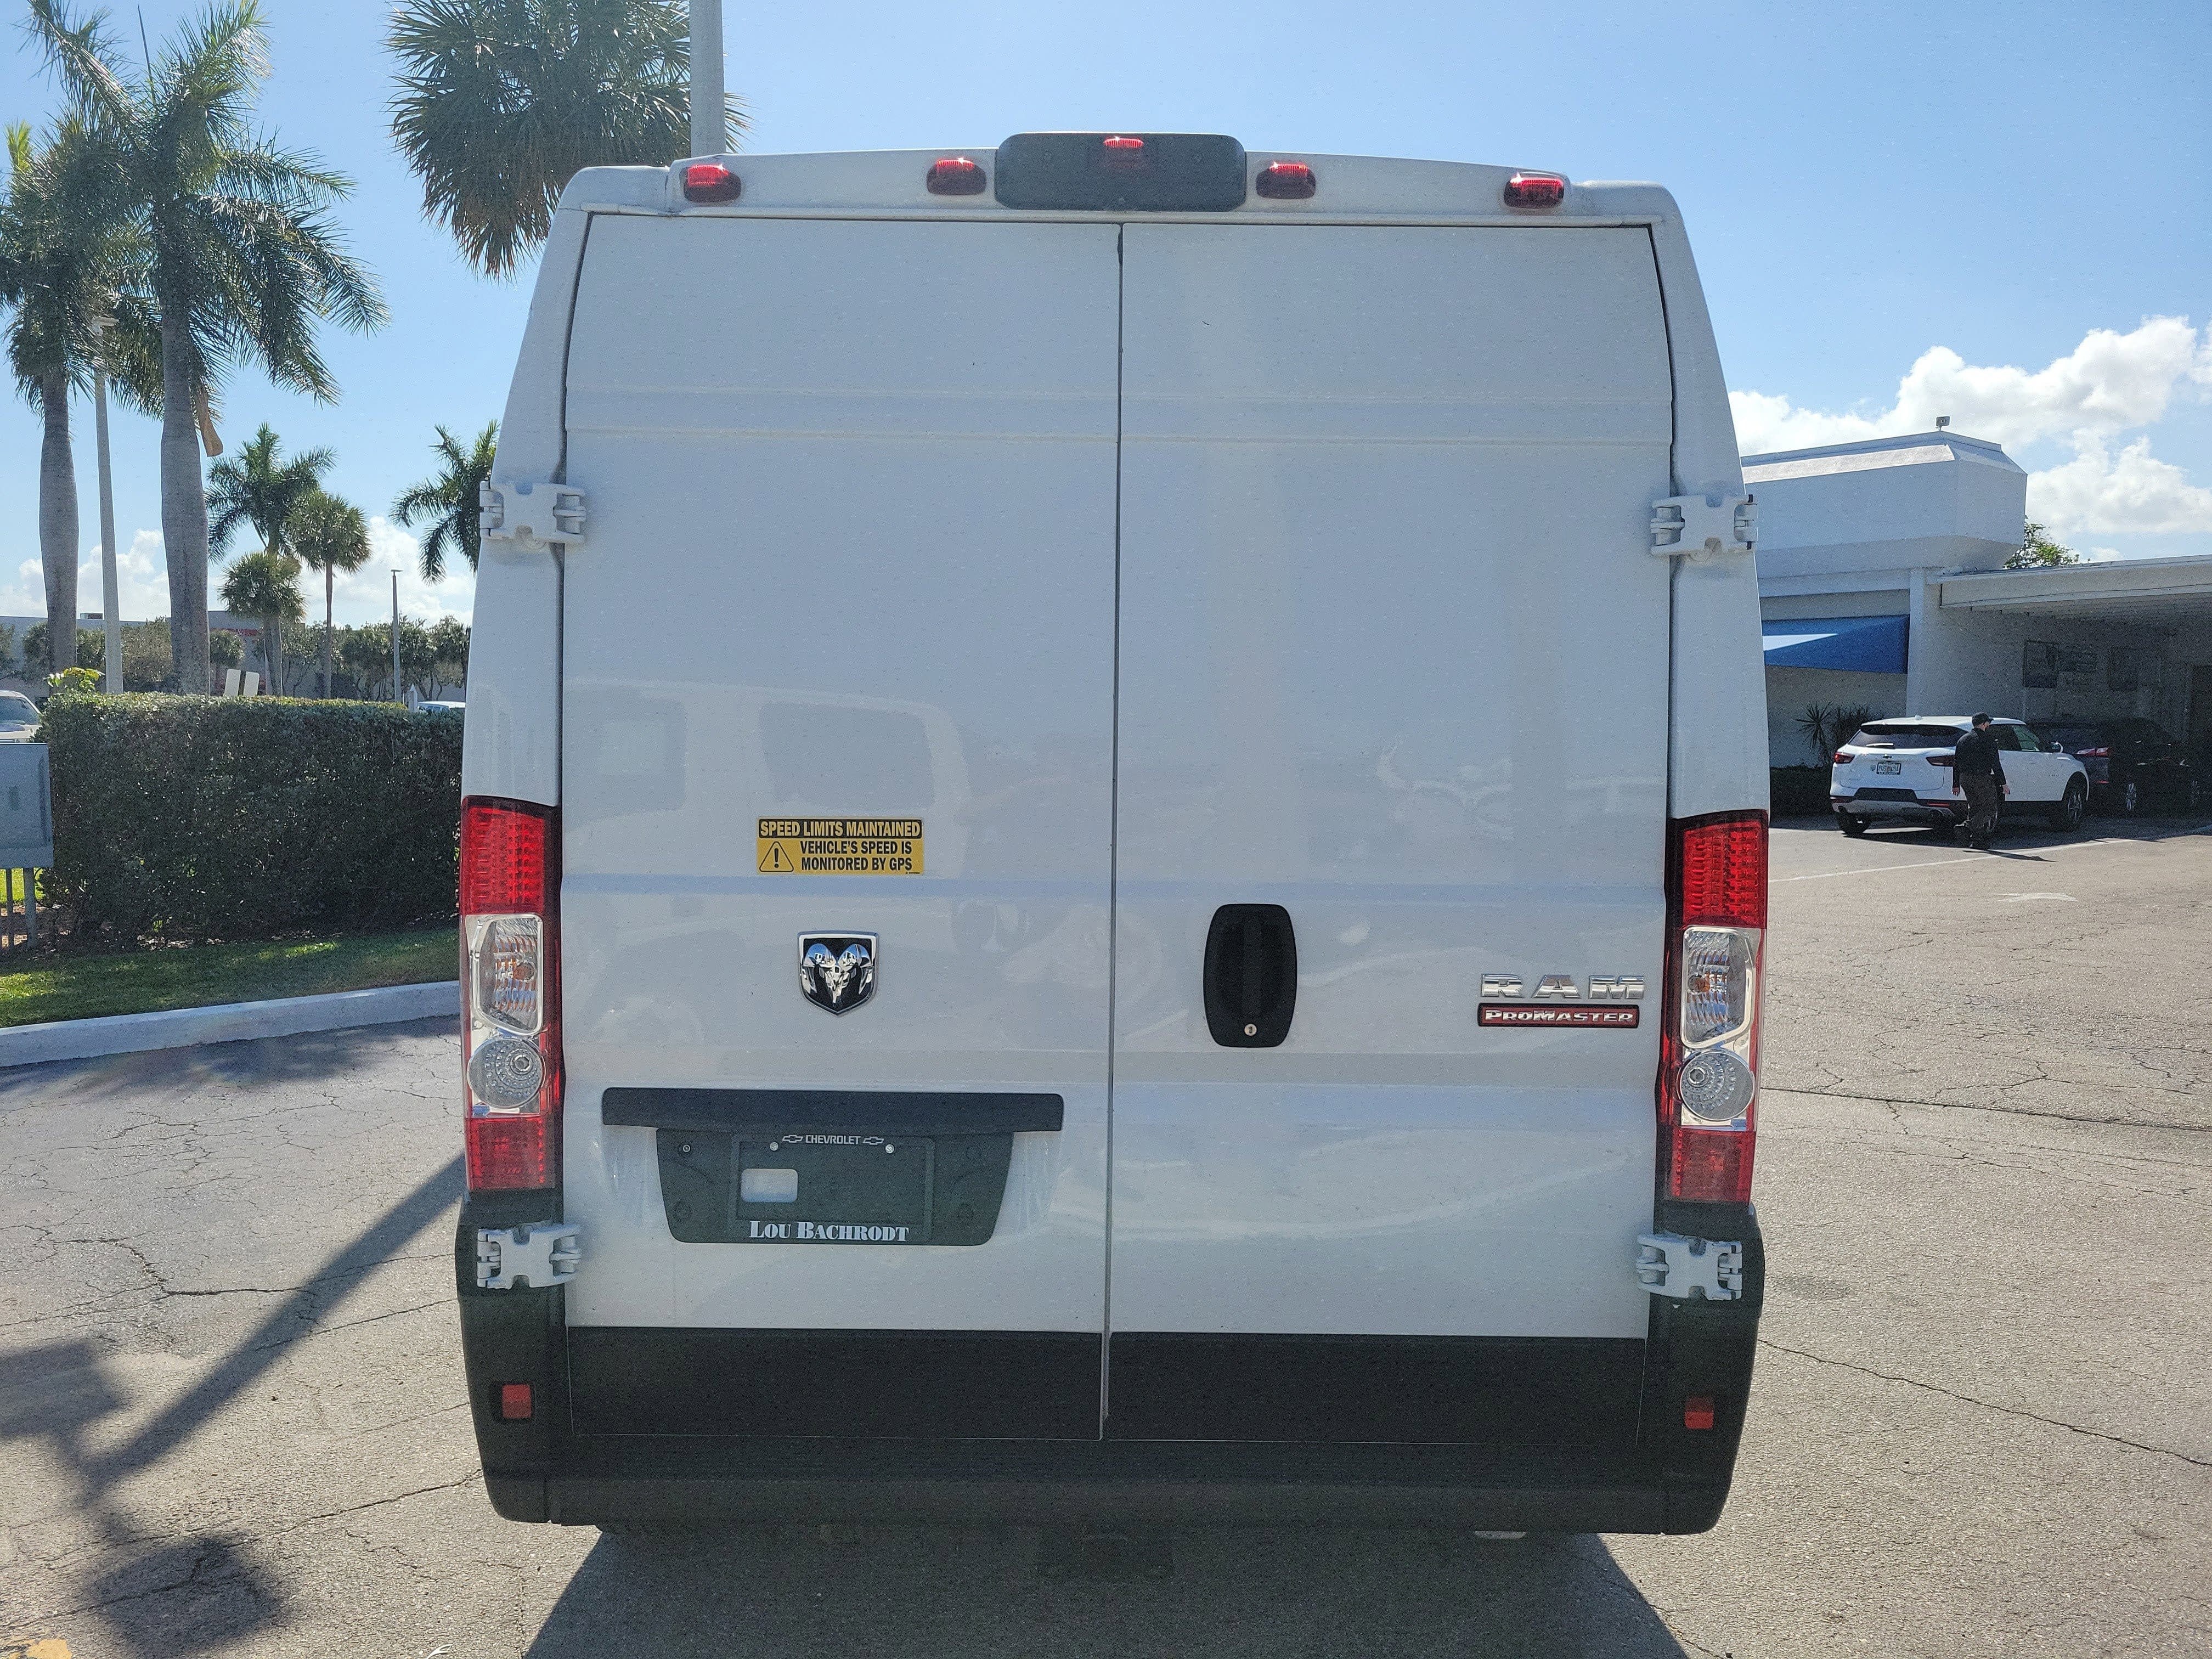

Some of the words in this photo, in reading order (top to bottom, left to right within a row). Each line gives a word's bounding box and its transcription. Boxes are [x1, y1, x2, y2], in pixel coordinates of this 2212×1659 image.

[760, 821, 800, 837] SPEED
[804, 821, 844, 837] LIMITS
[847, 821, 921, 837] MAINTAINED
[800, 840, 858, 854] VEHICLE'S
[861, 841, 898, 854] SPEED
[901, 841, 912, 854] IS
[801, 857, 868, 871] MONITORED
[872, 857, 887, 871] BY
[889, 857, 912, 871] GPS
[1481, 974, 1645, 1000] RAM
[1485, 1009, 1633, 1023] PROMASTER
[805, 1135, 861, 1145] CHEVROLET
[749, 1220, 792, 1239] LOU
[796, 1221, 910, 1242] BACHRODT
